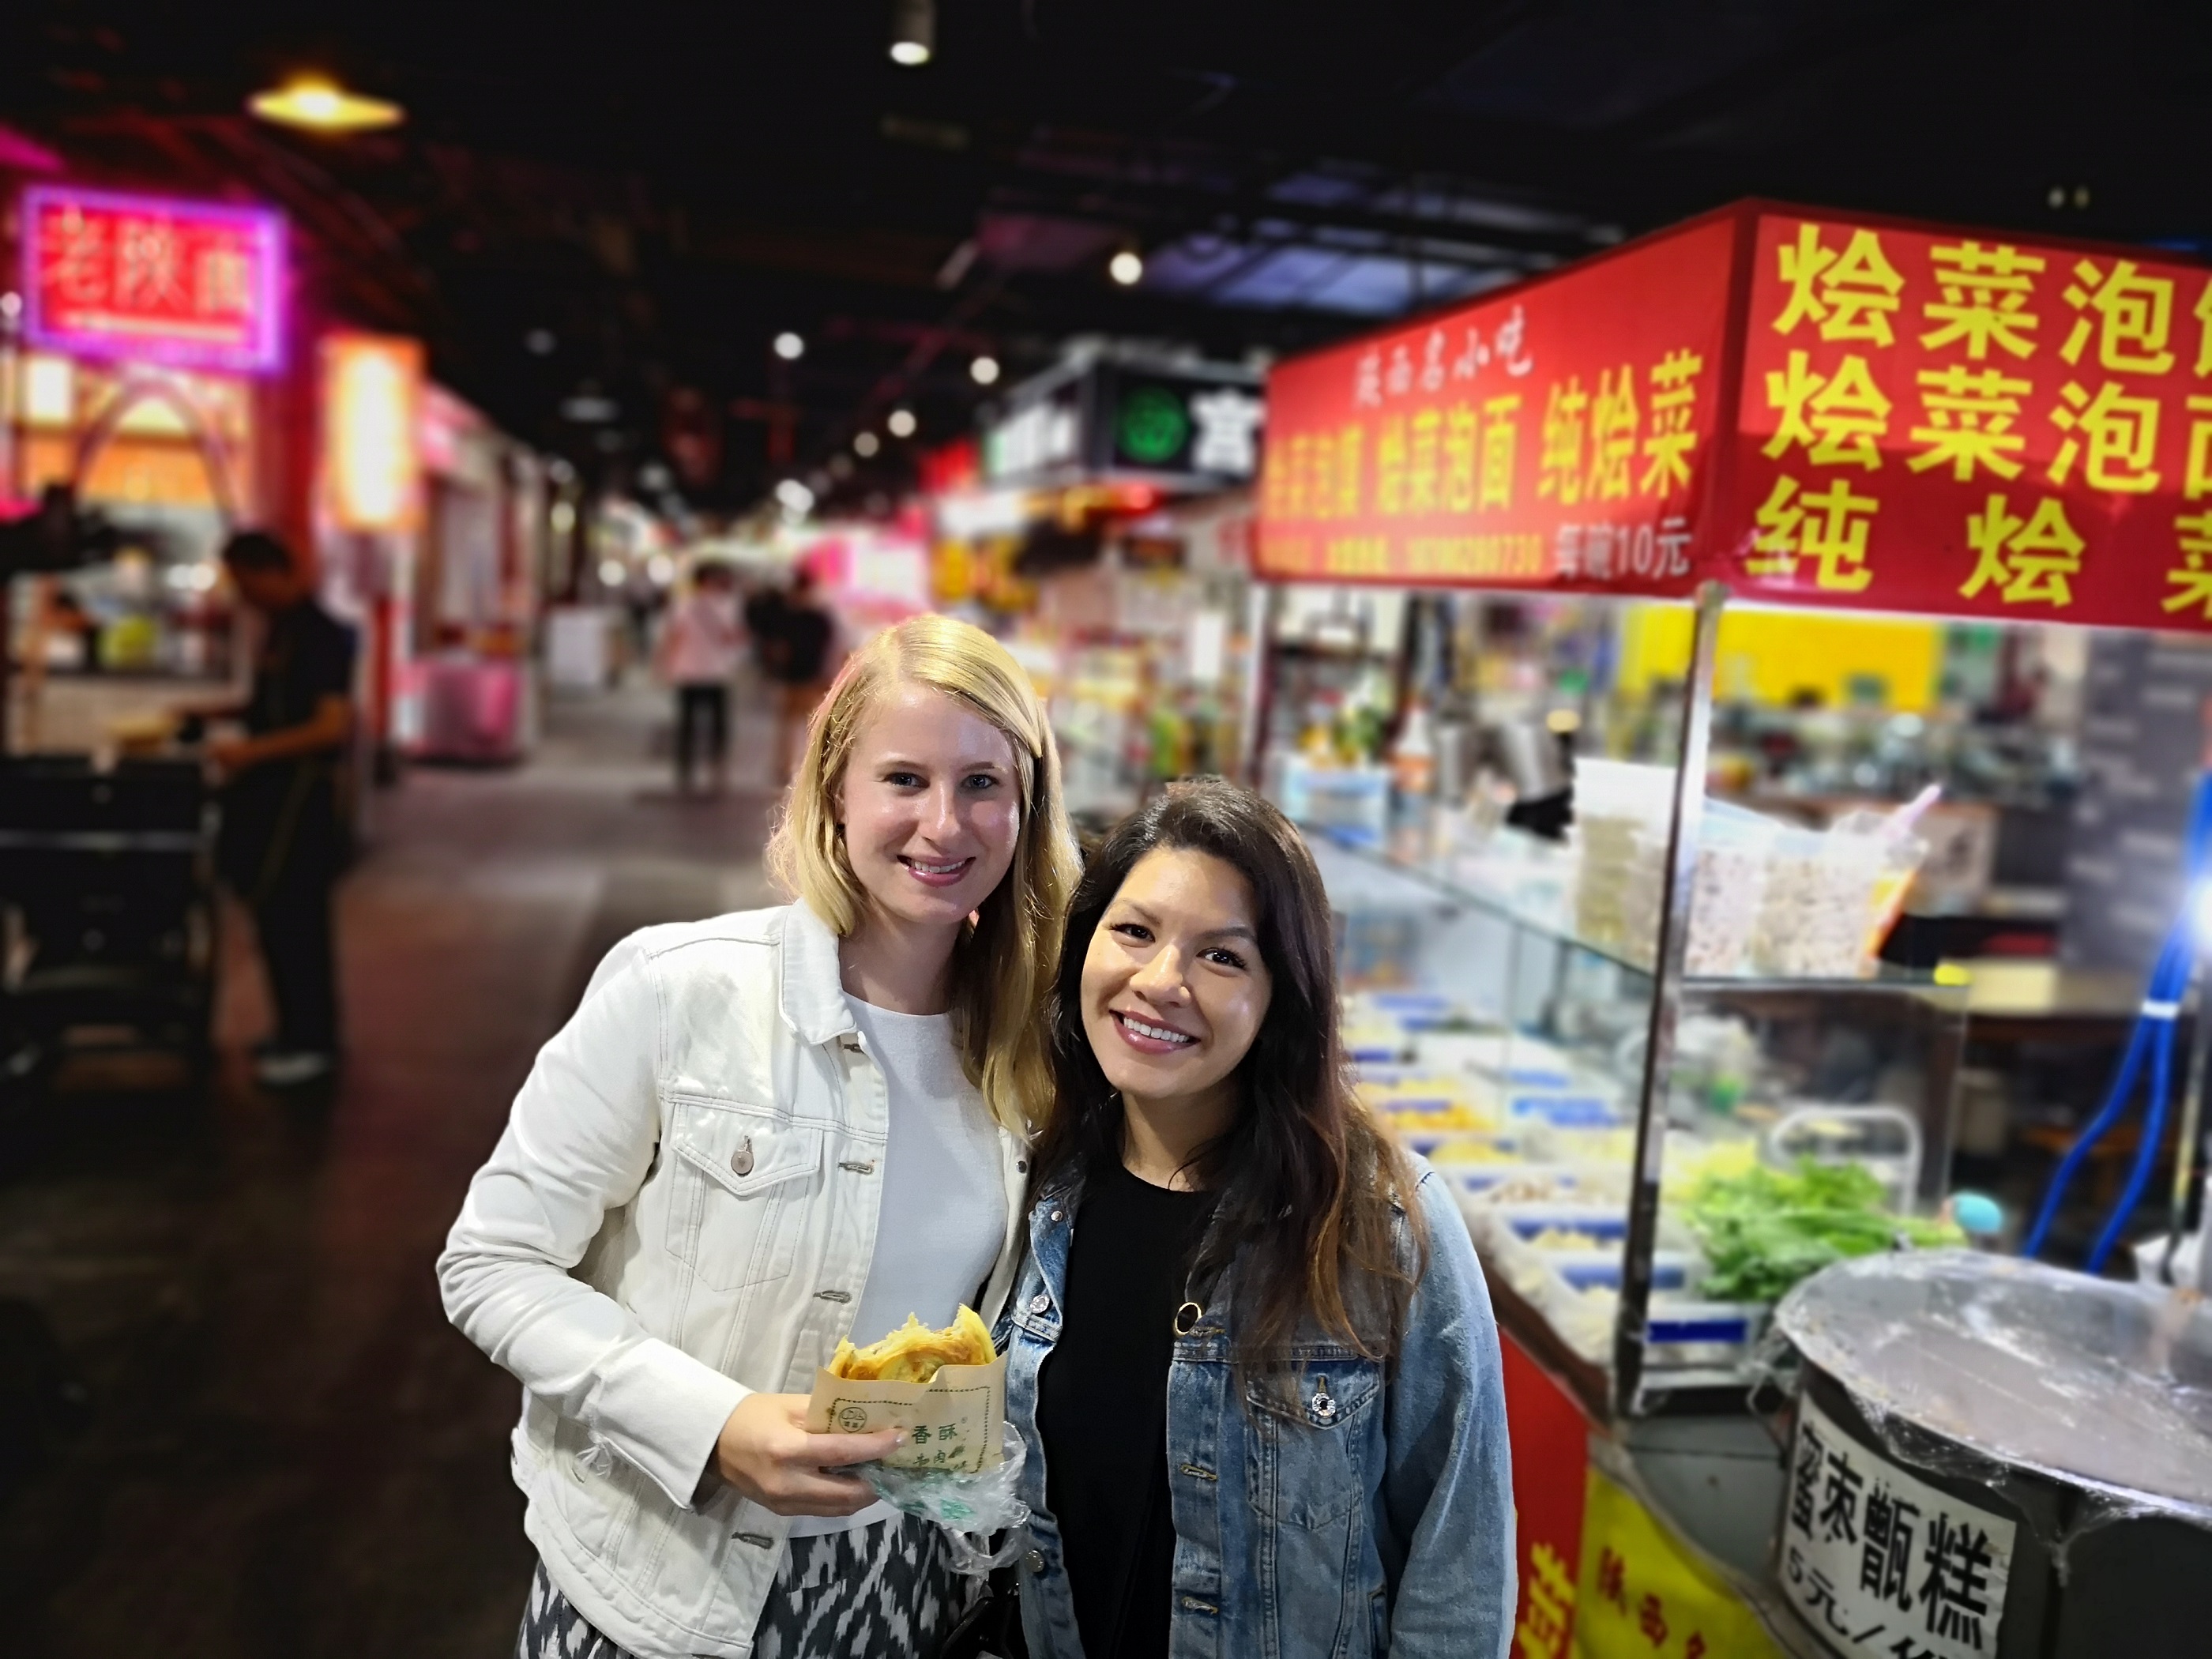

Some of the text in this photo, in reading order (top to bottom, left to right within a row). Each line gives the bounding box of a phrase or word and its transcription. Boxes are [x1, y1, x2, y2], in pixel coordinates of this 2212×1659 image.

[1772, 222, 2212, 378] 烩菜泡
[1760, 349, 2212, 499] 烩菜泡
[912, 1423, 957, 1445] 香酥
